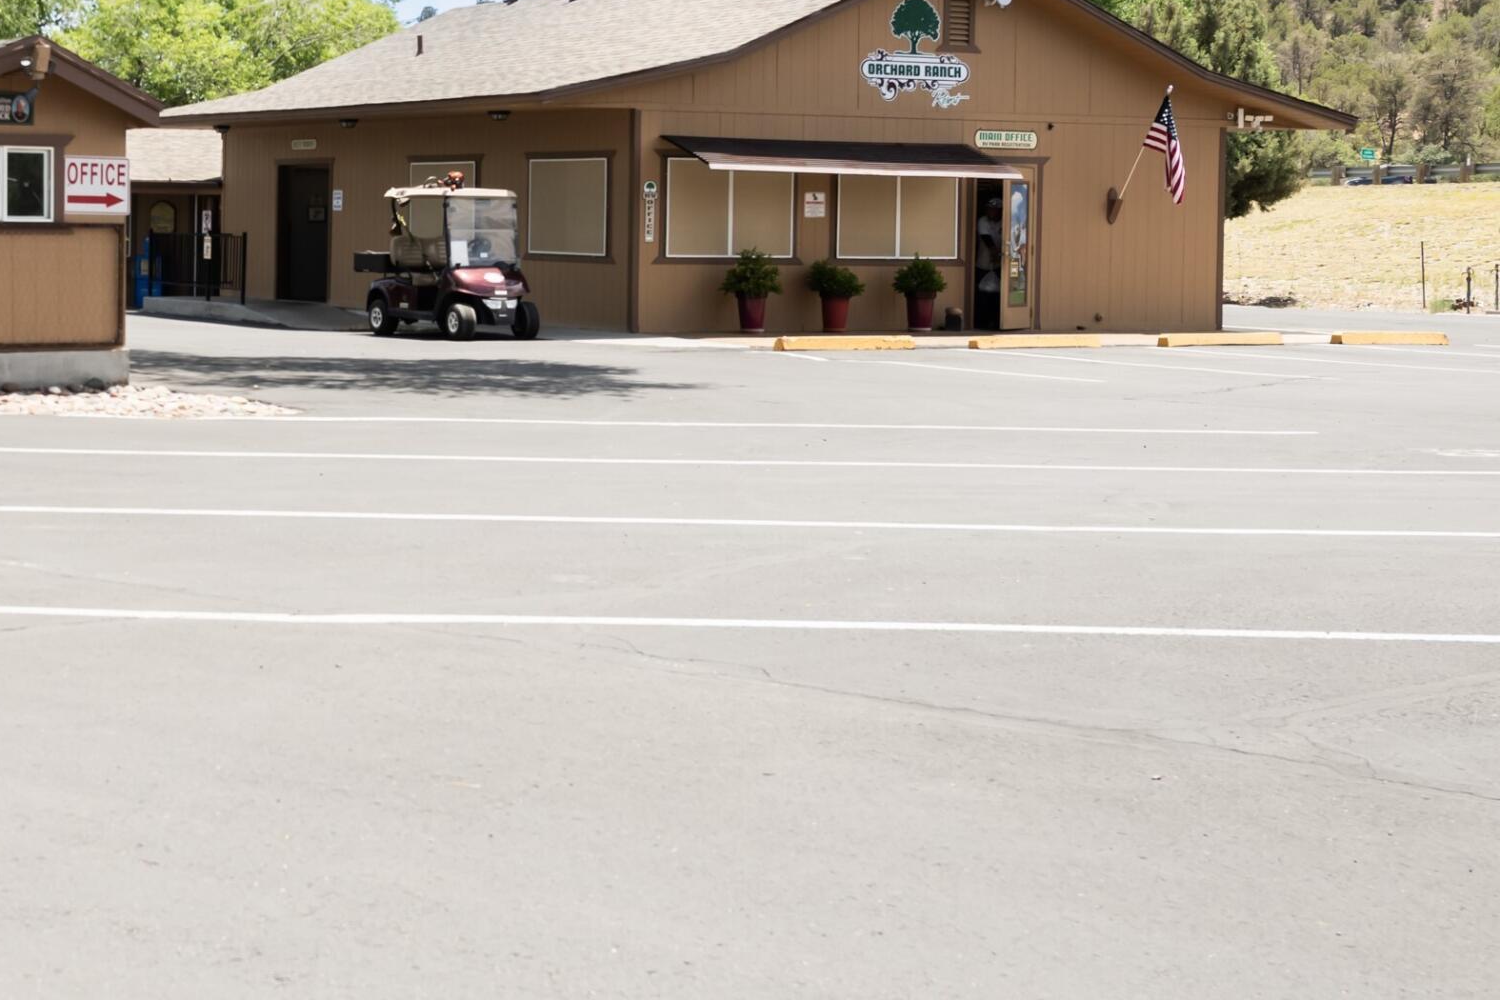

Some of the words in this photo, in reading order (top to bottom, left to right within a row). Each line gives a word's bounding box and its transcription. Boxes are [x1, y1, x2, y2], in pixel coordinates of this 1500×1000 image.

[867, 63, 920, 77] ORCHARD
[925, 65, 962, 78] RANCH
[979, 132, 1002, 141] MAIN
[1004, 132, 1033, 142] OFFICE
[67, 162, 126, 186] OFFICE
